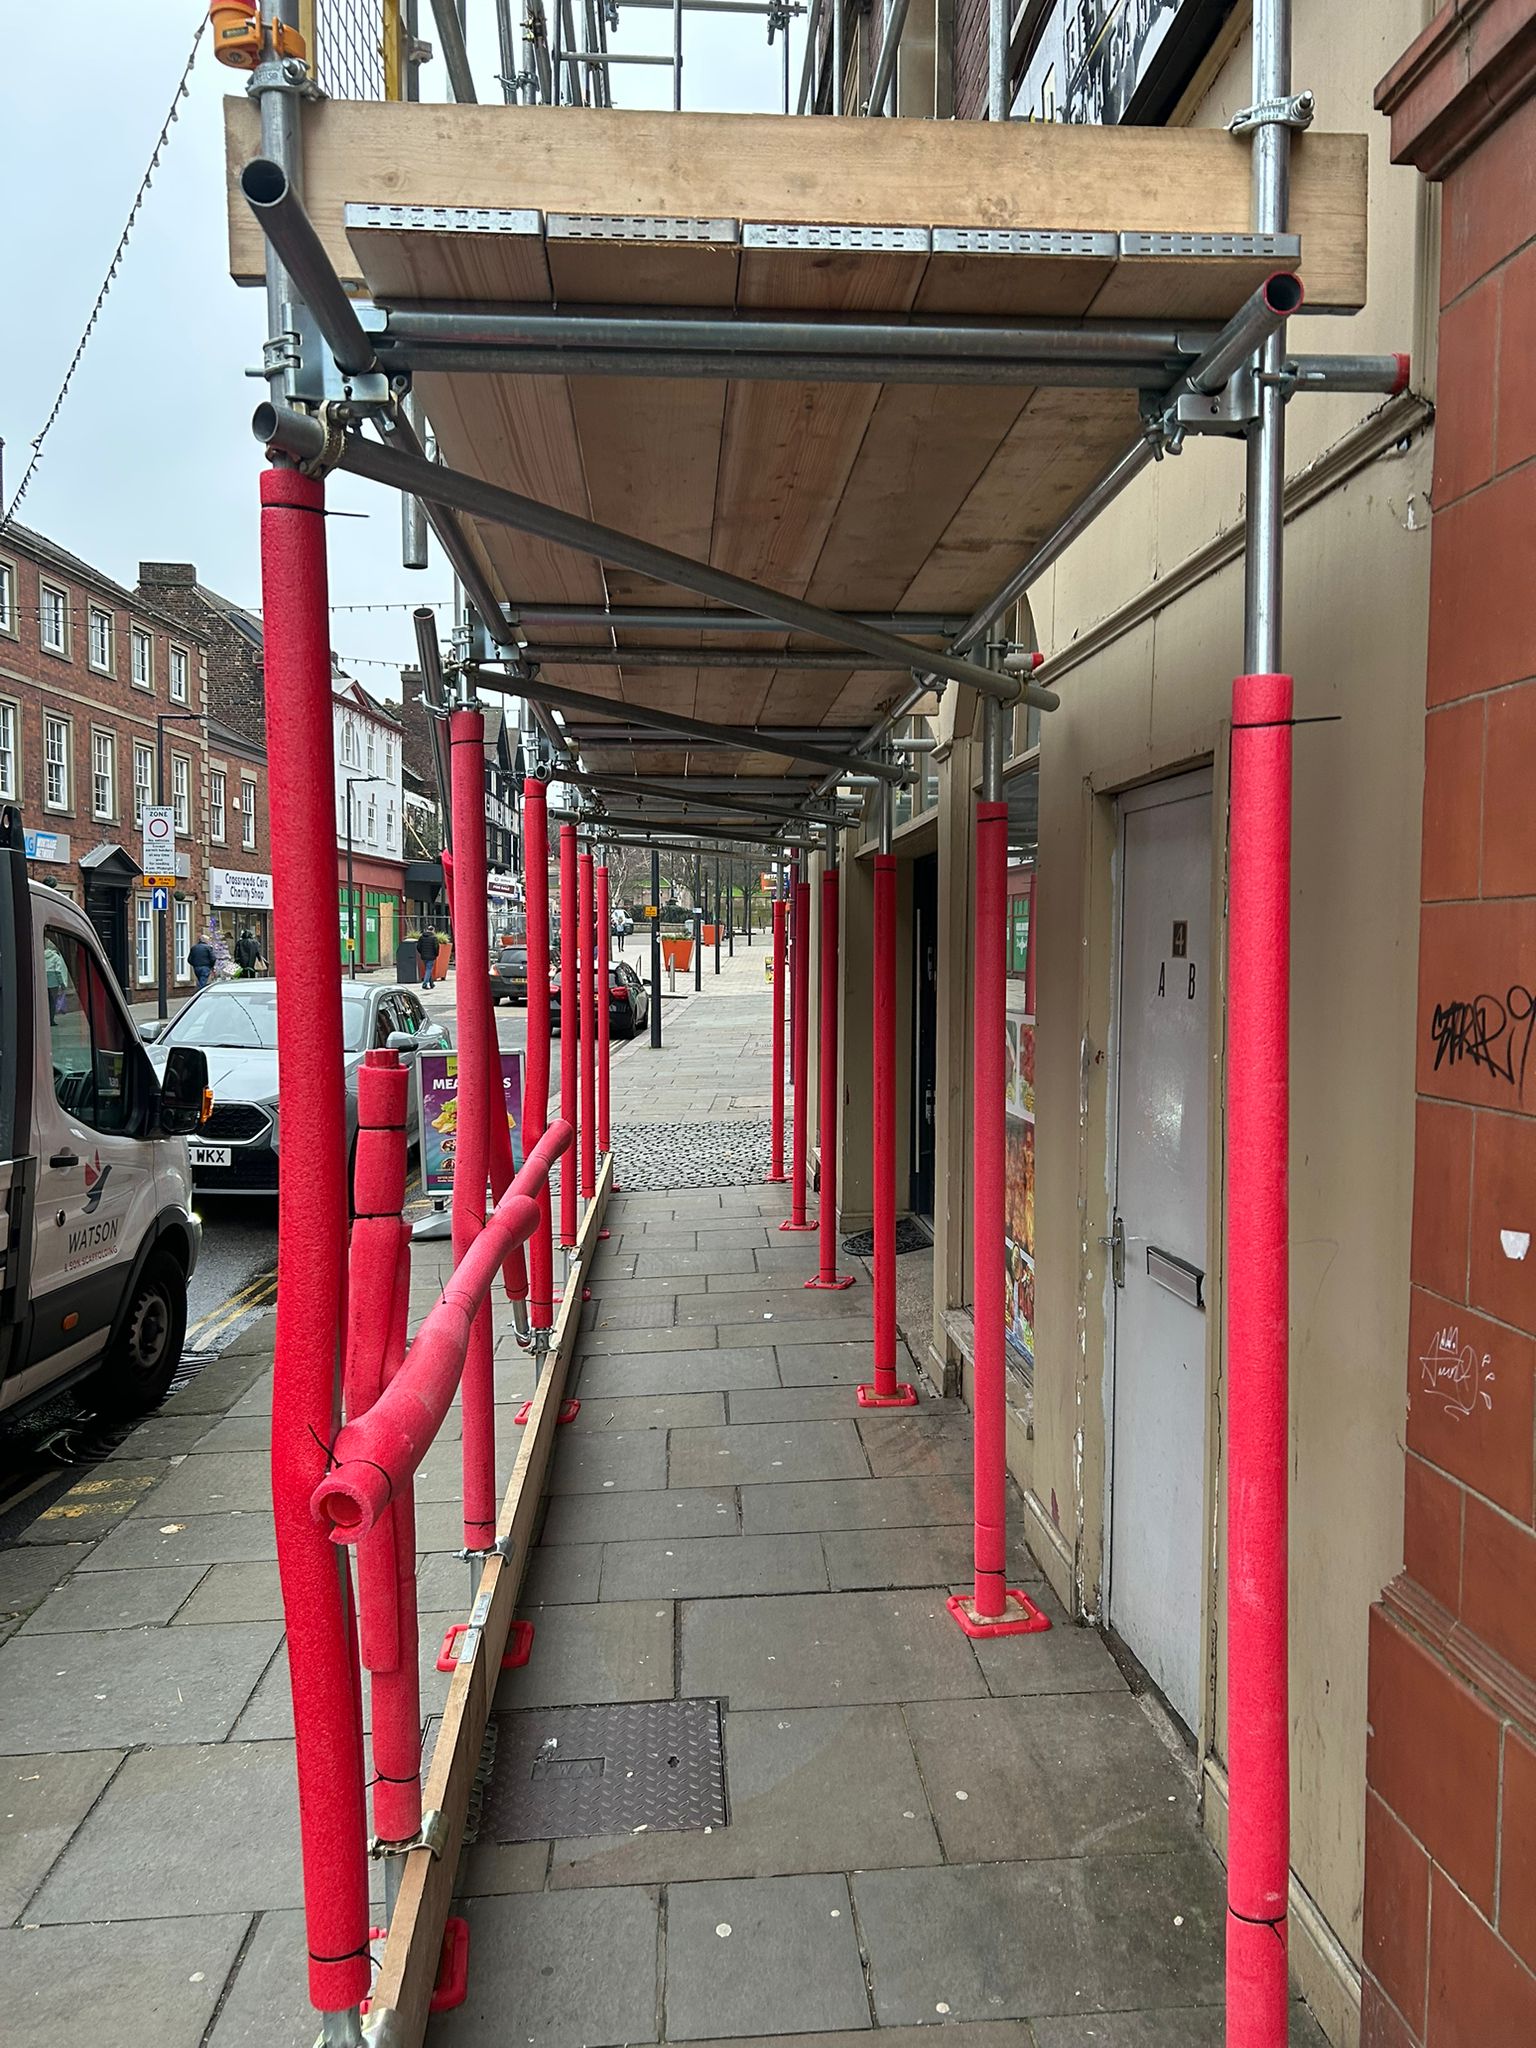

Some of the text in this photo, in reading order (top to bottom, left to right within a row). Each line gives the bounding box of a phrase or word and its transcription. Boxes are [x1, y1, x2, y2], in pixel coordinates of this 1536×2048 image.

[225, 872, 268, 888] Crossroads Care
[230, 885, 250, 902] Charity
[251, 887, 265, 902] Shop
[1158, 961, 1196, 1000] A B
[196, 1149, 225, 1163] WKX
[68, 1217, 119, 1254] WATSON
[81, 1244, 118, 1266] SCAFFOLDING
